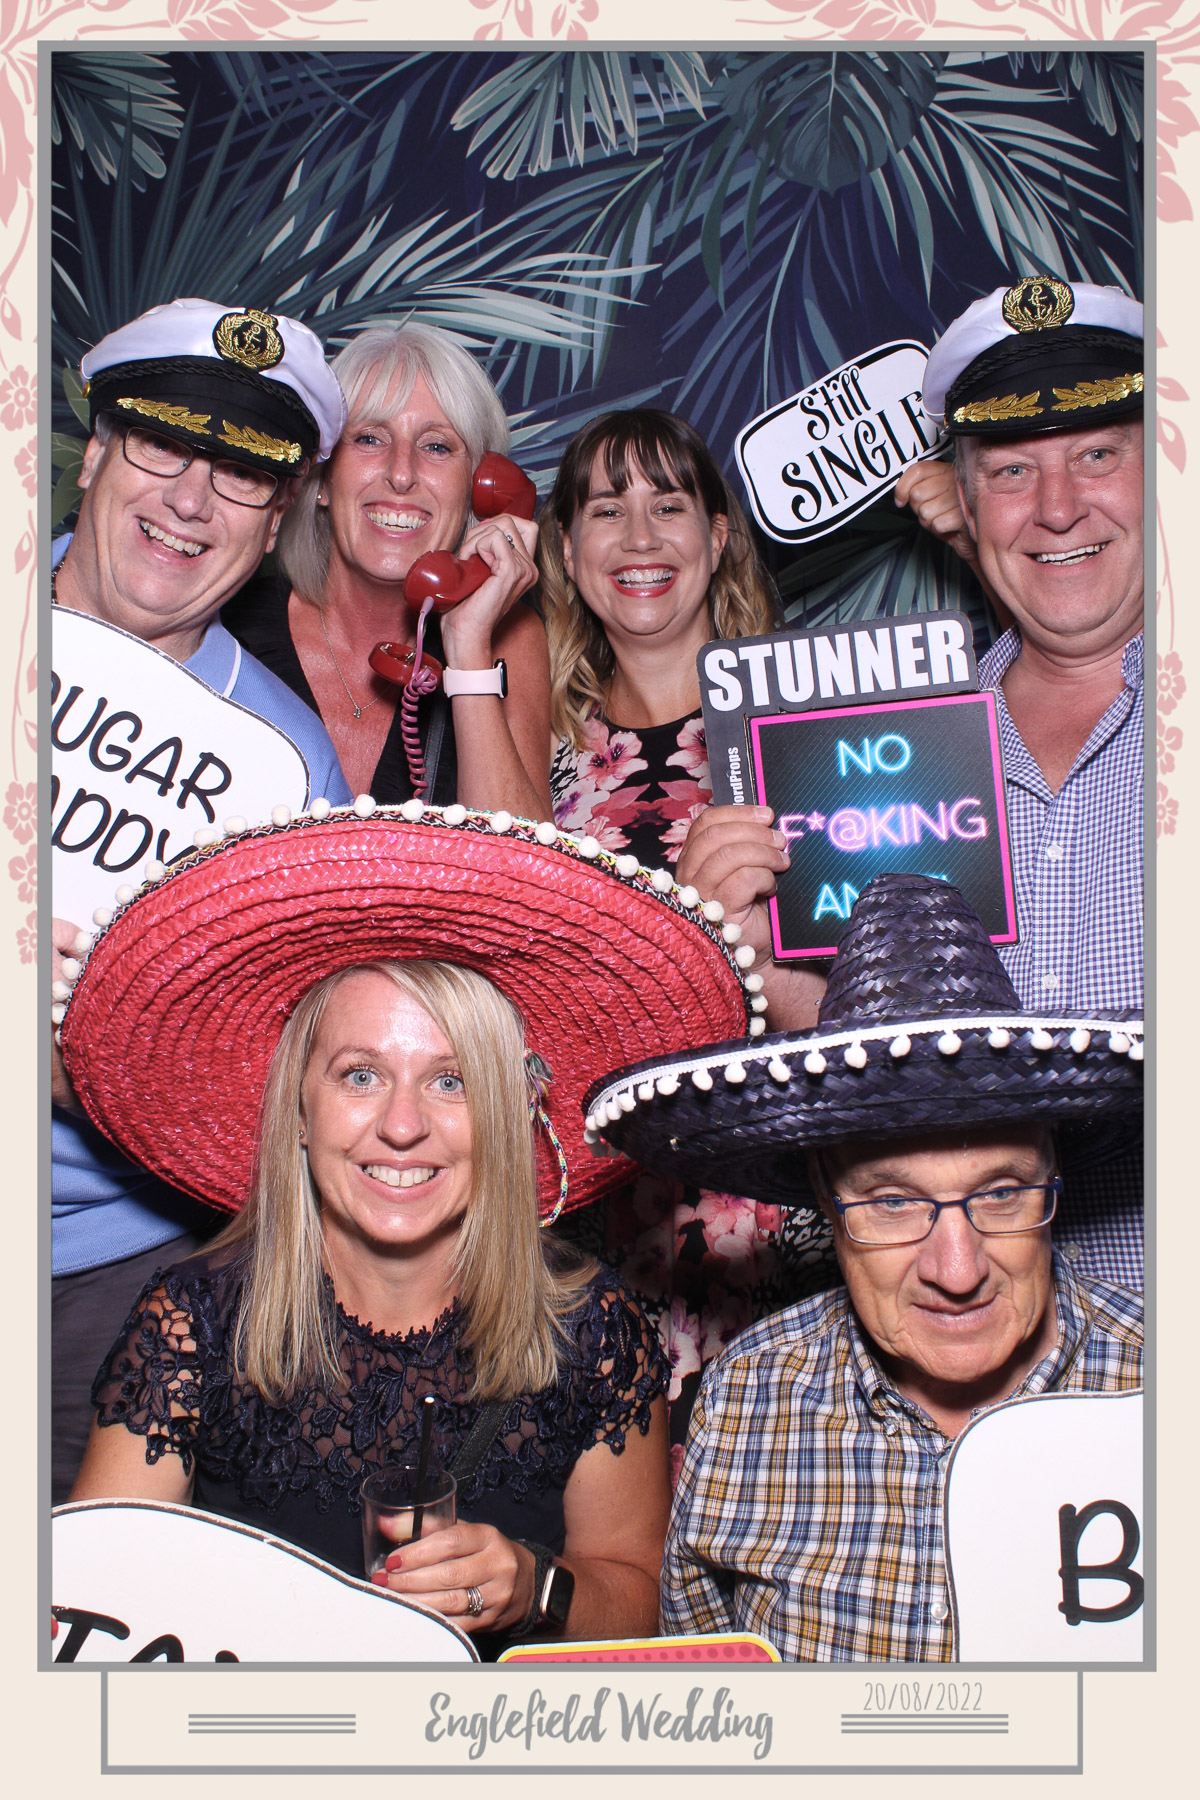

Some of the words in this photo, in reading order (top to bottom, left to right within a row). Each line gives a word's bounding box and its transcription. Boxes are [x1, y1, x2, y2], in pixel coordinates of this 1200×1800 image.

[799, 367, 872, 441] Still
[781, 390, 941, 523] SINGLE
[704, 618, 971, 713] STUNNER
[837, 734, 912, 777] NO
